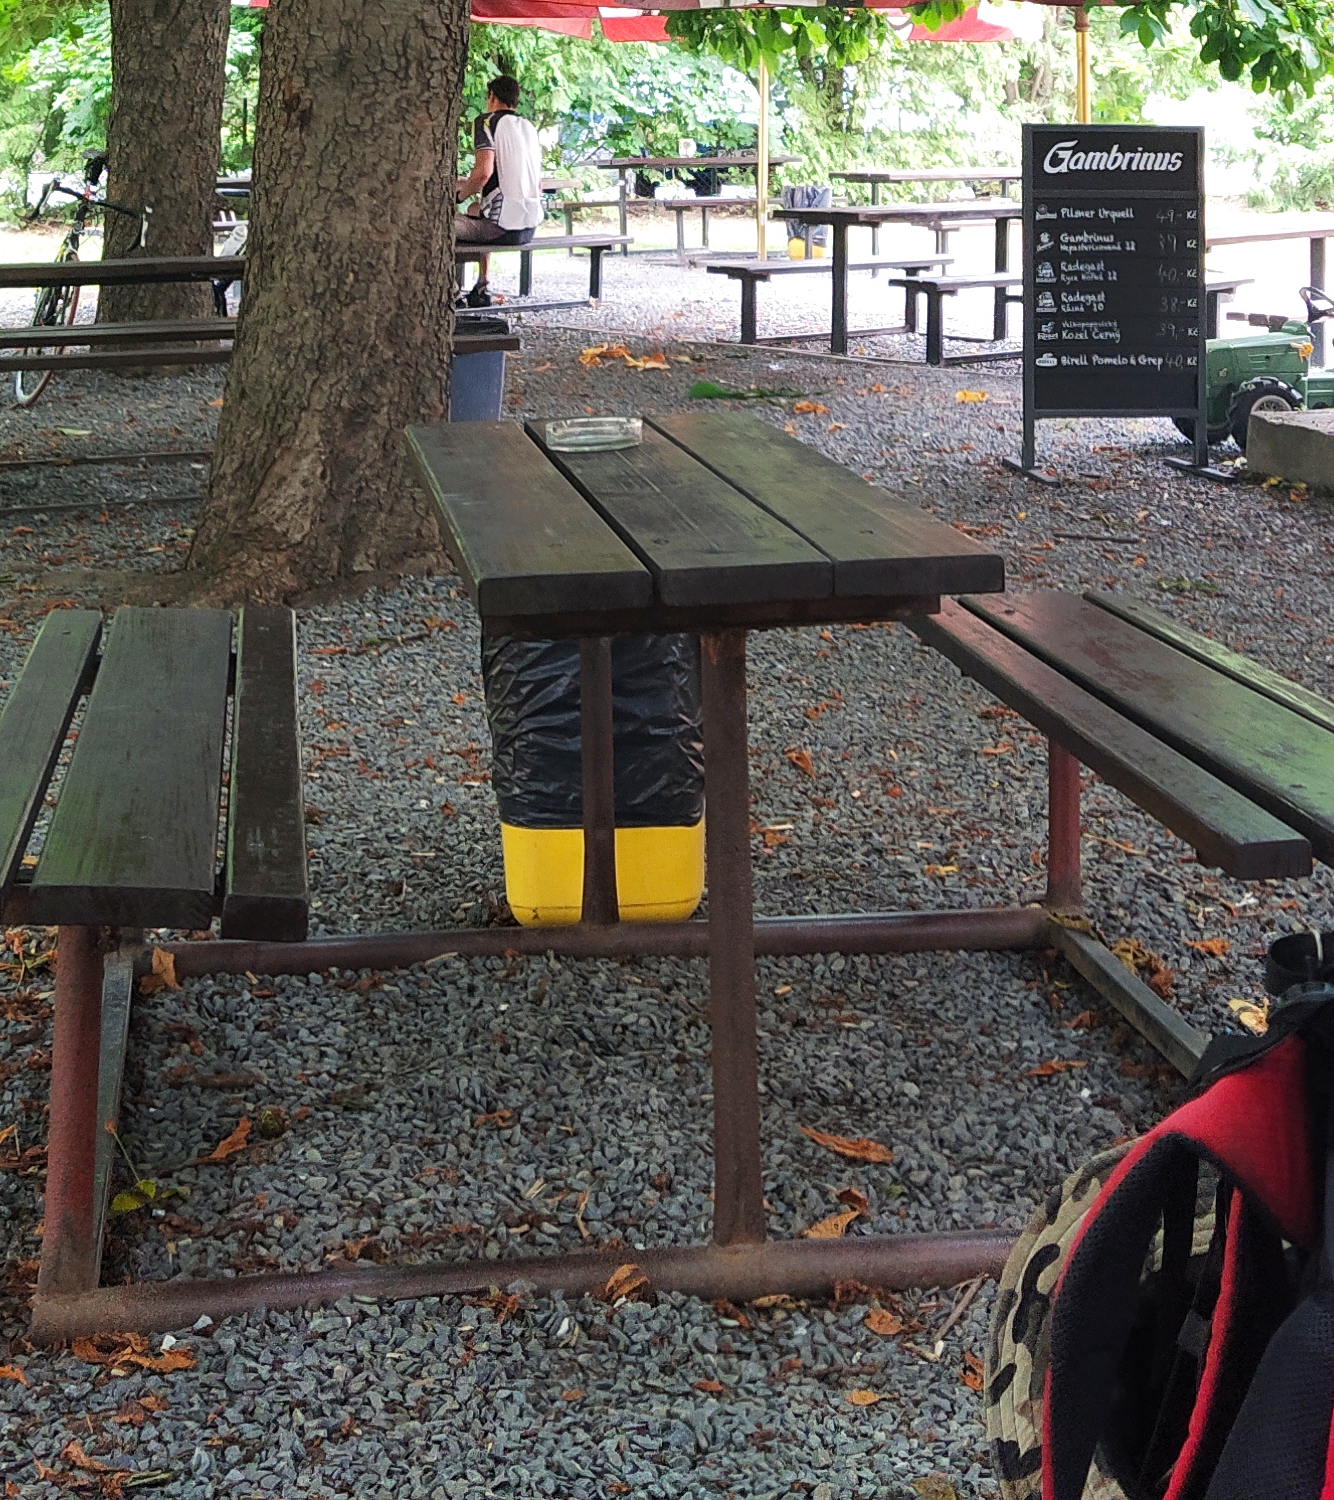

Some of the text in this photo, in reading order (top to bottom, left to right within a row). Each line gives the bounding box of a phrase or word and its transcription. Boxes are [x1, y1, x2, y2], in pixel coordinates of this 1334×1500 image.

[1043, 140, 1184, 174] Gambrinus
[1060, 207, 1095, 219] Pilsner
[1098, 207, 1135, 224] Urquell
[1060, 230, 1115, 243] Gambrinus
[1060, 259, 1105, 274] Radegast
[1060, 289, 1106, 306] Radegast
[1092, 302, 1104, 312] 10
[1062, 329, 1089, 340] Kozel
[1092, 328, 1121, 344] Černý
[1060, 354, 1089, 366] Birell
[1092, 354, 1128, 366] Pomelo
[1138, 354, 1164, 371] Grep
